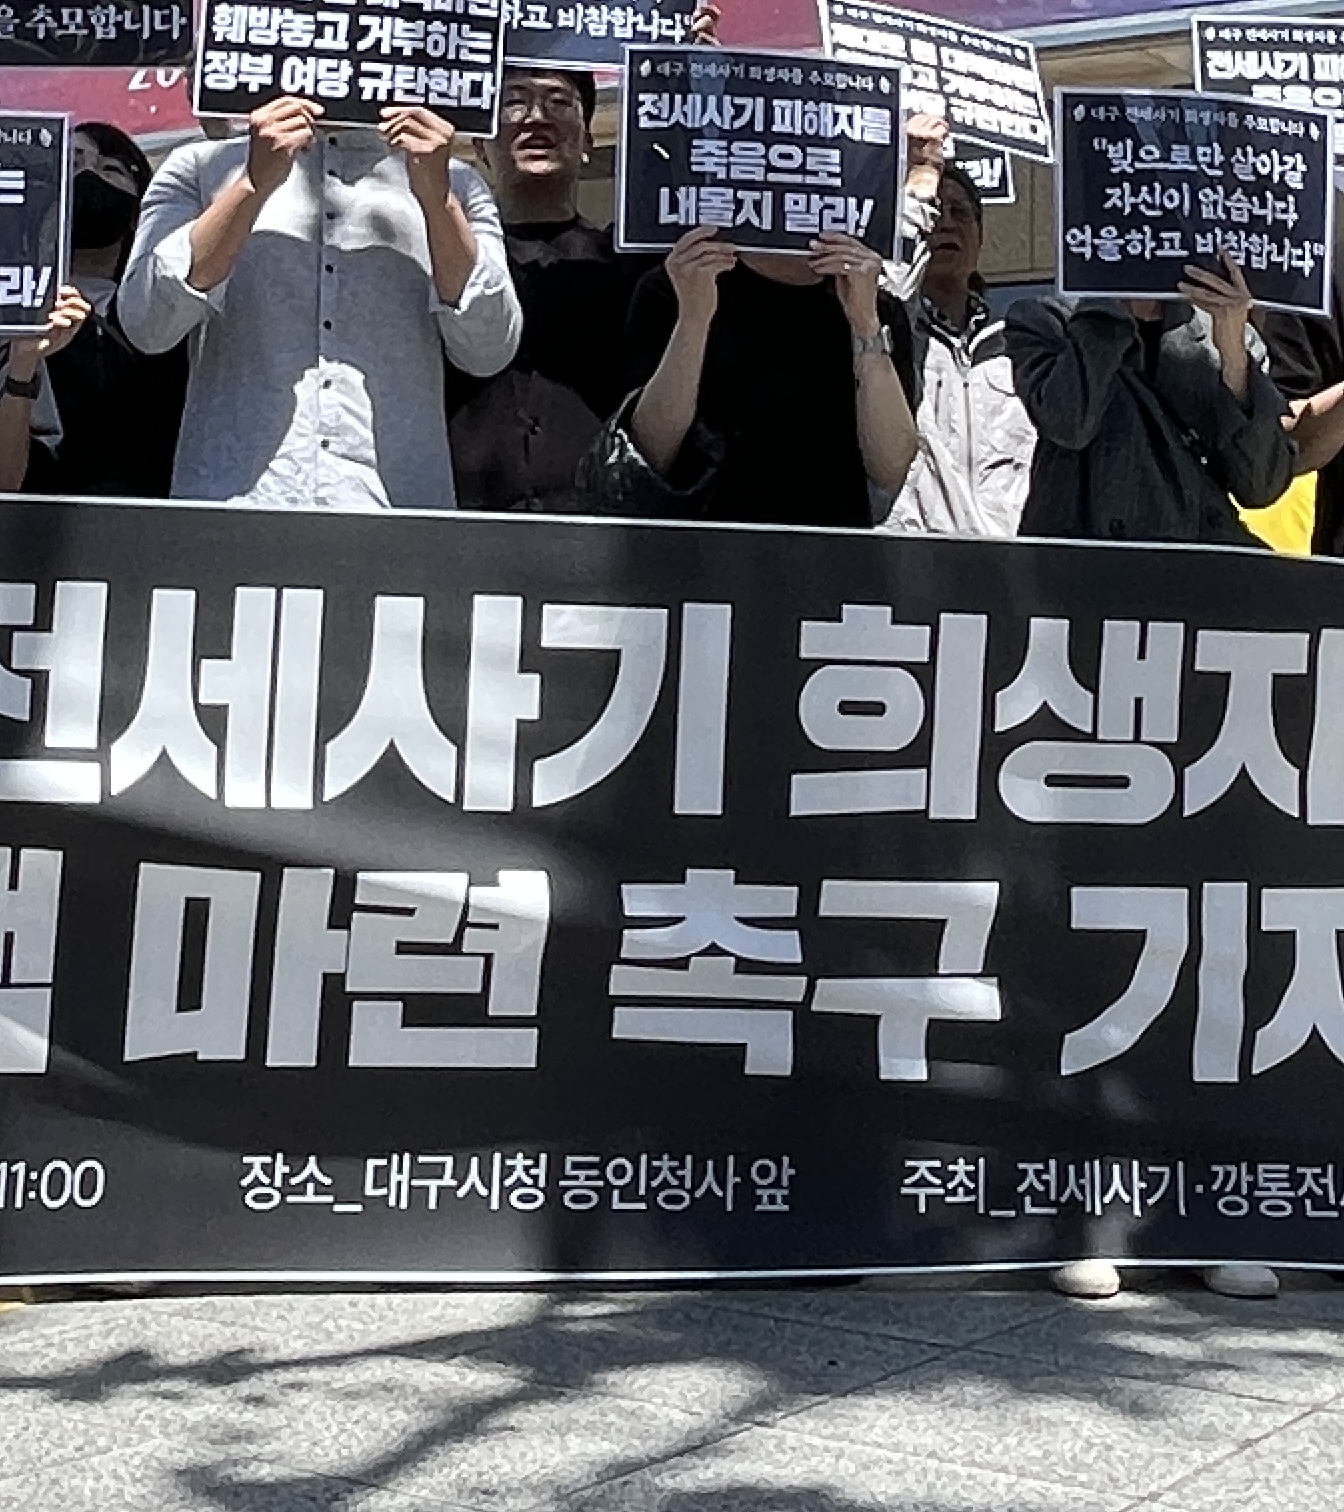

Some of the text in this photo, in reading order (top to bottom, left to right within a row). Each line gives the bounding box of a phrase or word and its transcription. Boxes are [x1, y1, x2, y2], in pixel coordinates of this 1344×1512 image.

[25, 3, 188, 39] 추모합니다
[357, 14, 494, 63] 거부하는
[205, 50, 274, 92] 정부
[281, 54, 354, 99] 여당
[359, 62, 496, 109] 규탄한다
[637, 93, 765, 133] 전세사기
[690, 138, 842, 187] 죽음으로
[1230, 145, 1307, 189] 살아갈
[659, 186, 874, 237] 내몰지 말라!
[1103, 182, 1299, 230] 자신이 없습니다
[1065, 224, 1189, 261] 억울하고
[122, 863, 551, 1070] 마련
[608, 866, 1002, 1081] 촉구
[239, 1152, 797, 1215] 장소_대구시청 동인청사 앞
